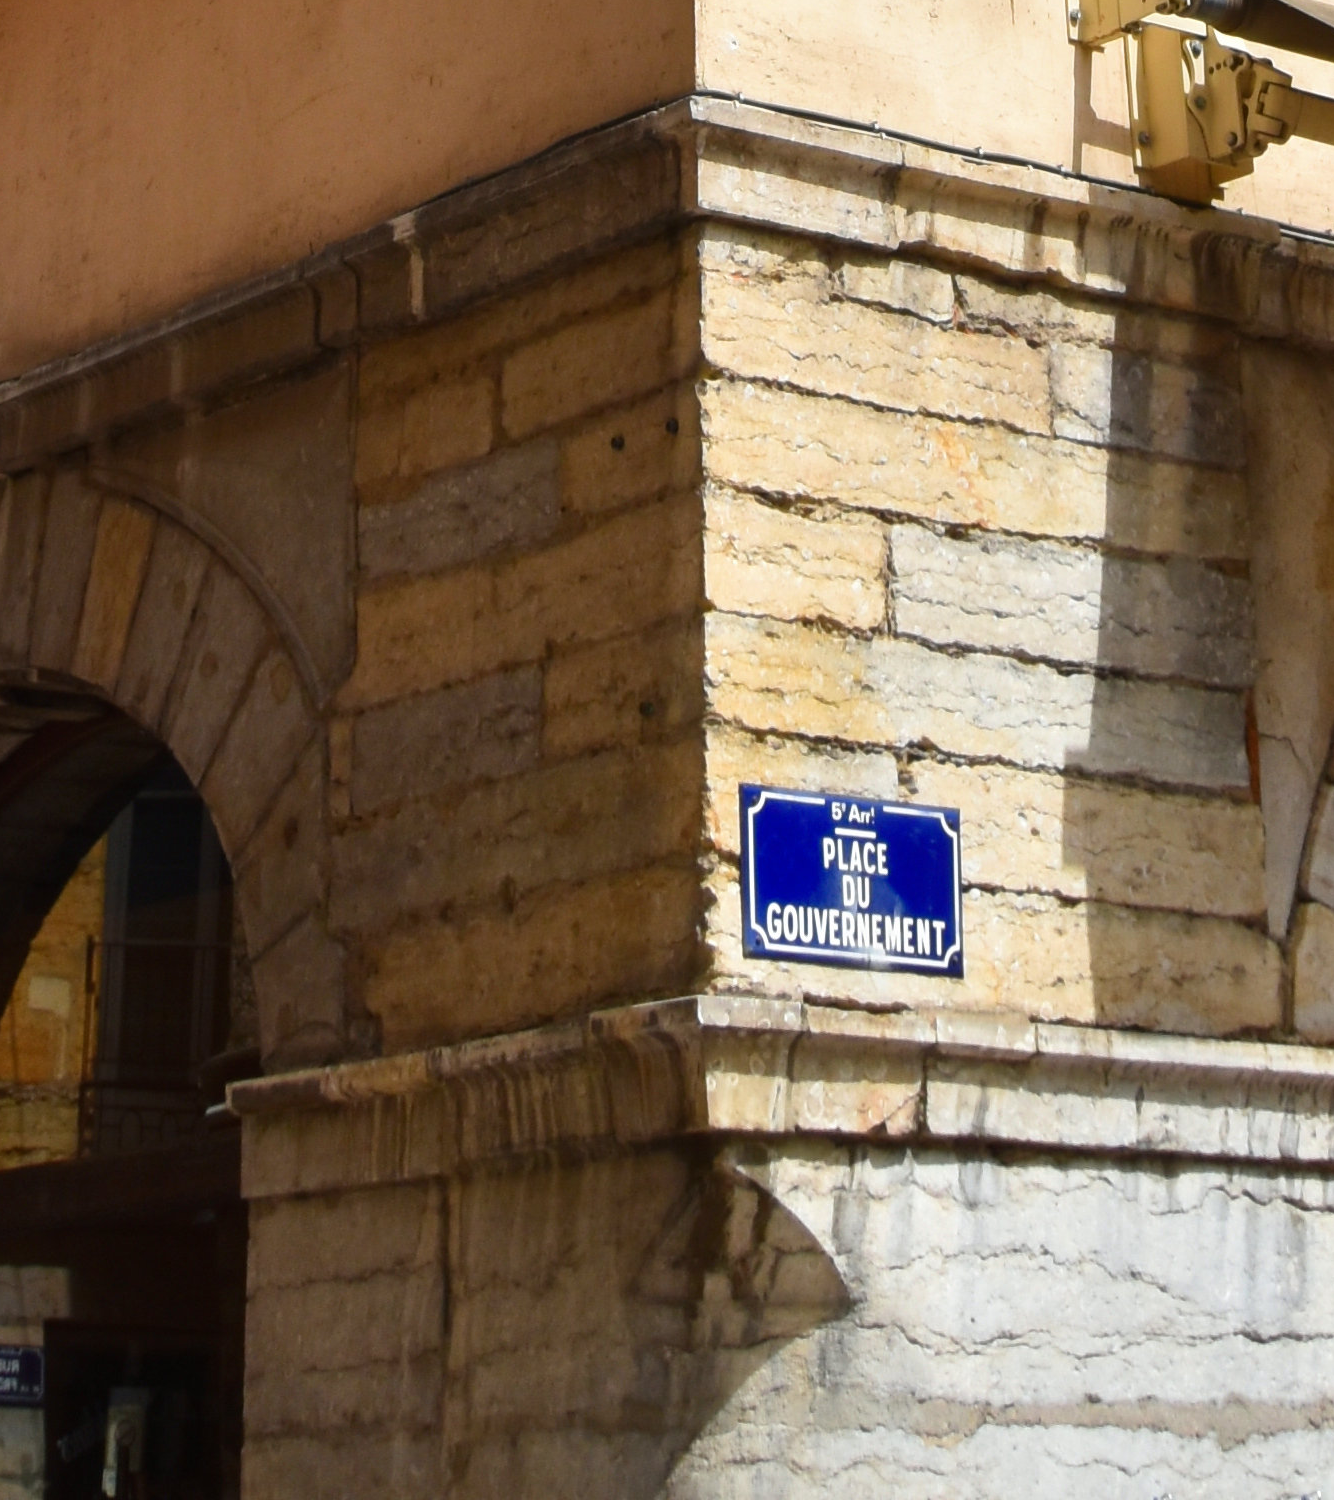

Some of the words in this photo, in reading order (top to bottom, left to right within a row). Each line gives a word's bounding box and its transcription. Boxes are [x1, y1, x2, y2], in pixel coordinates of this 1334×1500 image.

[823, 838, 889, 875] PLACE
[842, 875, 870, 908] DU
[767, 902, 945, 956] GOUVERNEMENT
